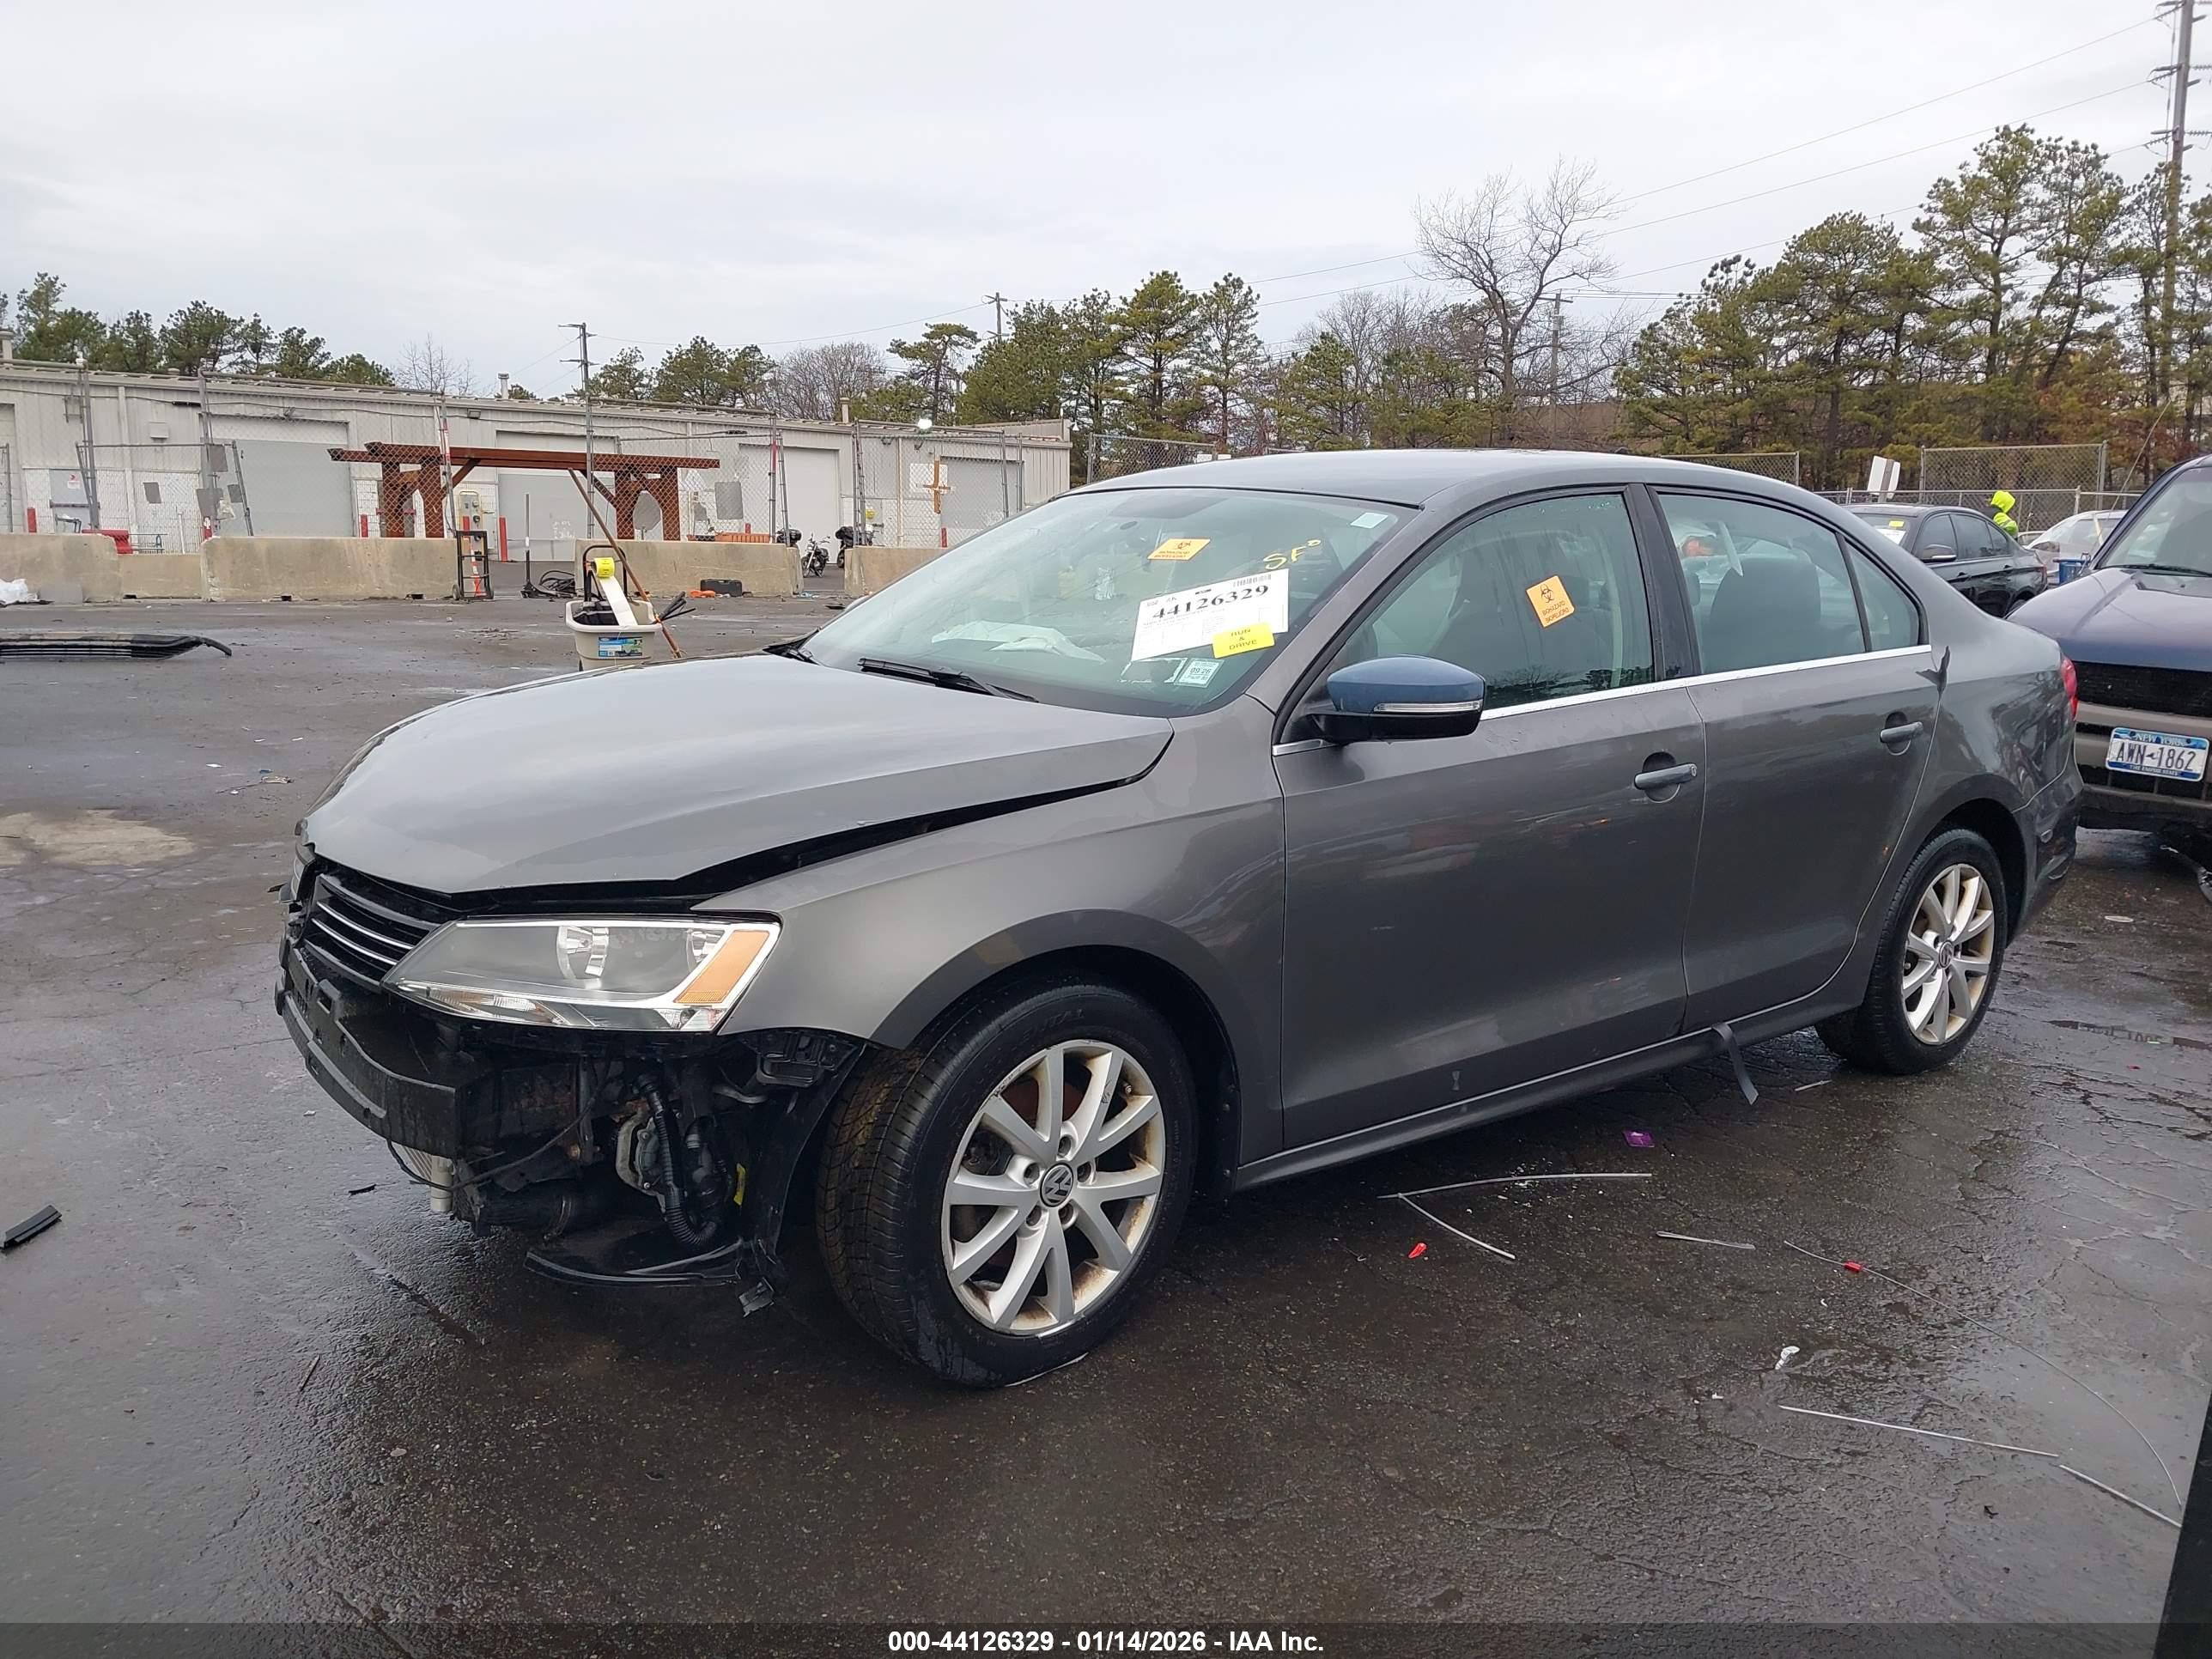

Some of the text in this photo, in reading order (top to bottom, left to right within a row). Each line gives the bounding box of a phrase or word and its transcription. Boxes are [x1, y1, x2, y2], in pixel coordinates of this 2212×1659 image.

[1152, 584, 1269, 618] 44126329
[1231, 628, 1251, 637] RUN
[1229, 639, 1258, 650] DRIVE
